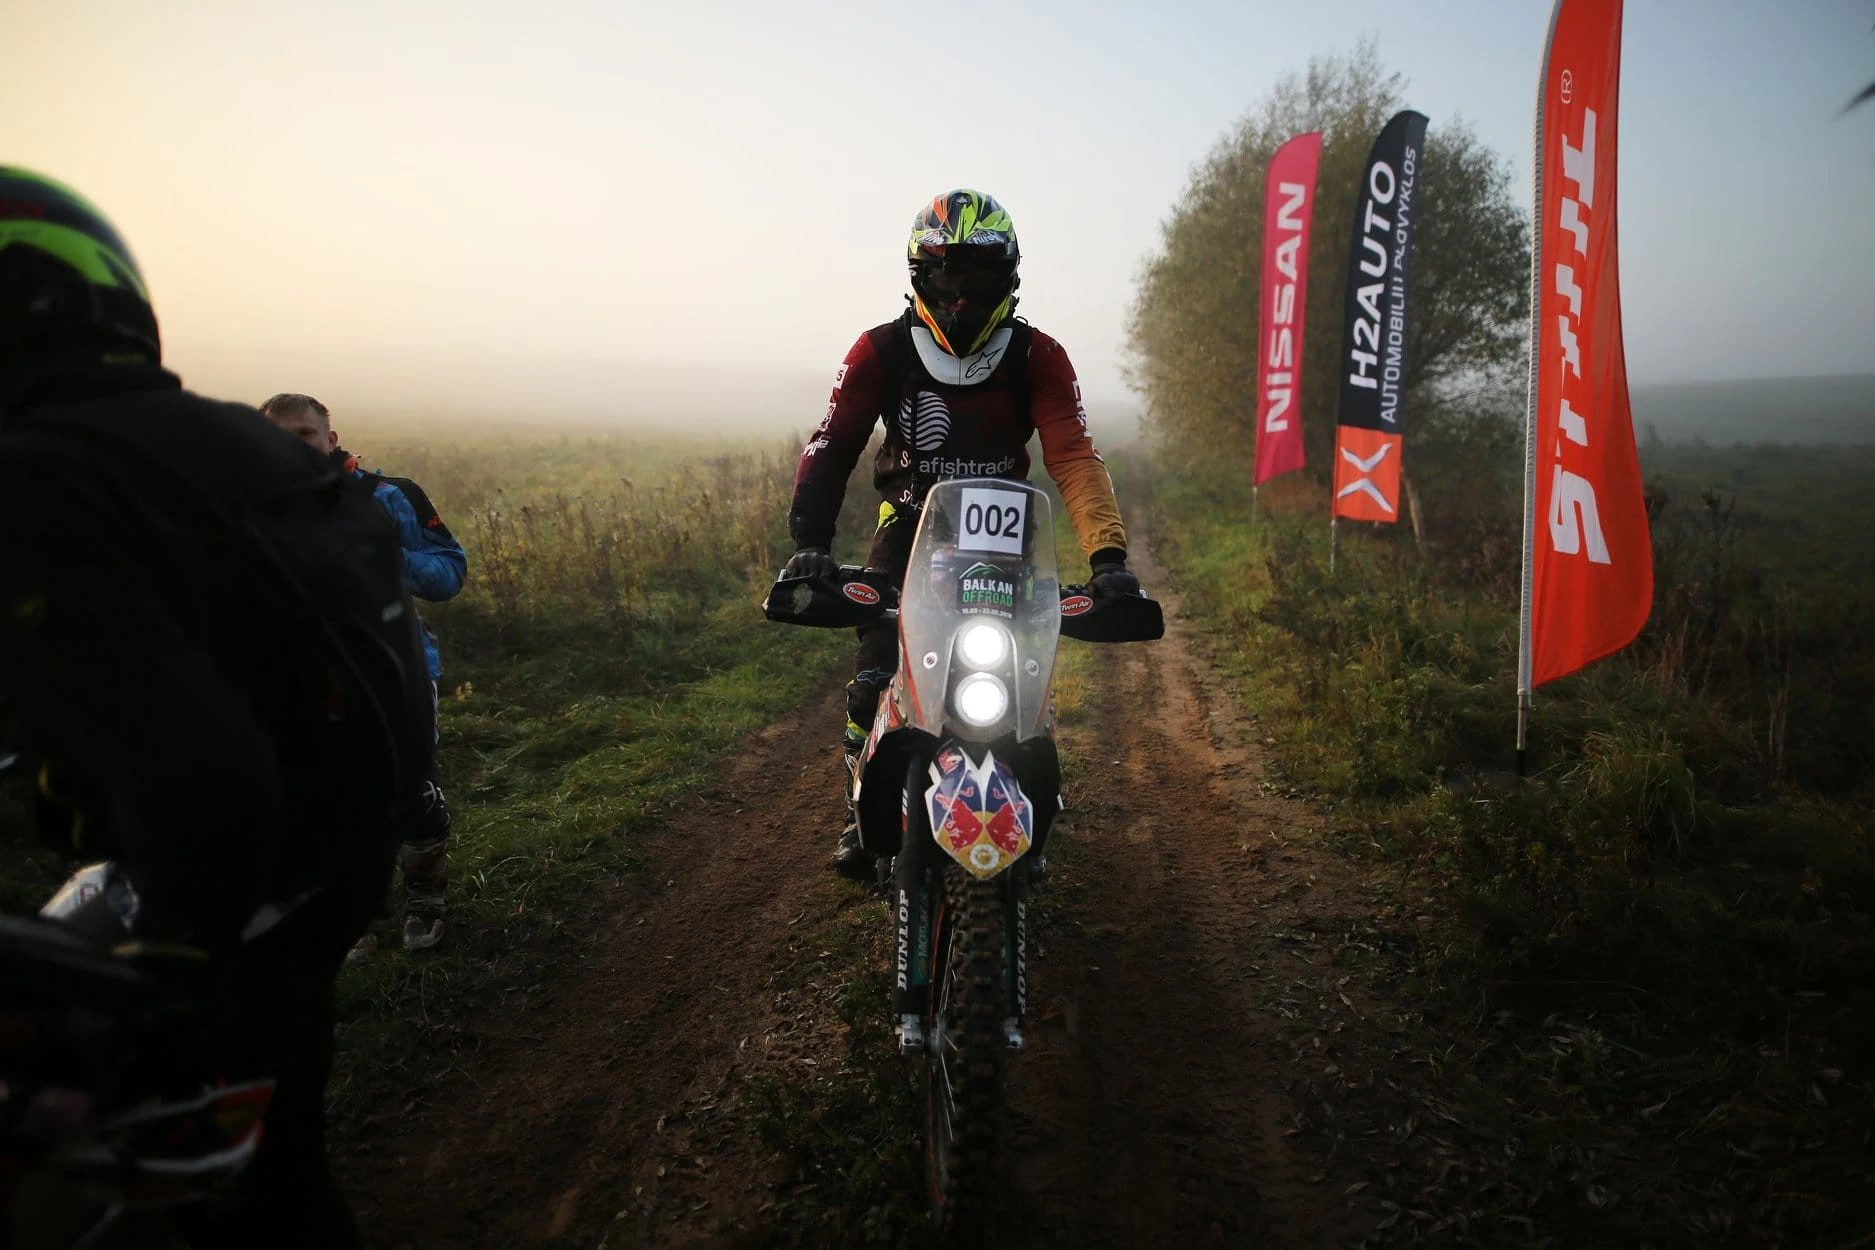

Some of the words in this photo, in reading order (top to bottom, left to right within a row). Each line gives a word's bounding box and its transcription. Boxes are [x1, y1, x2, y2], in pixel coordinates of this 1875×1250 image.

[1349, 160, 1396, 390] H2AUTO
[1265, 182, 1306, 433] NISSAN
[919, 456, 1016, 475] afishtrade
[964, 502, 1020, 539] 002
[847, 587, 865, 597] Twin
[864, 592, 876, 600] Air
[962, 591, 1013, 607] OFFROAD
[963, 578, 1013, 595] BALKAN
[1060, 603, 1078, 611] Twin
[1078, 600, 1090, 608] Air
[897, 889, 909, 991] DUNLOP
[1017, 899, 1026, 1015] DUNLOP
